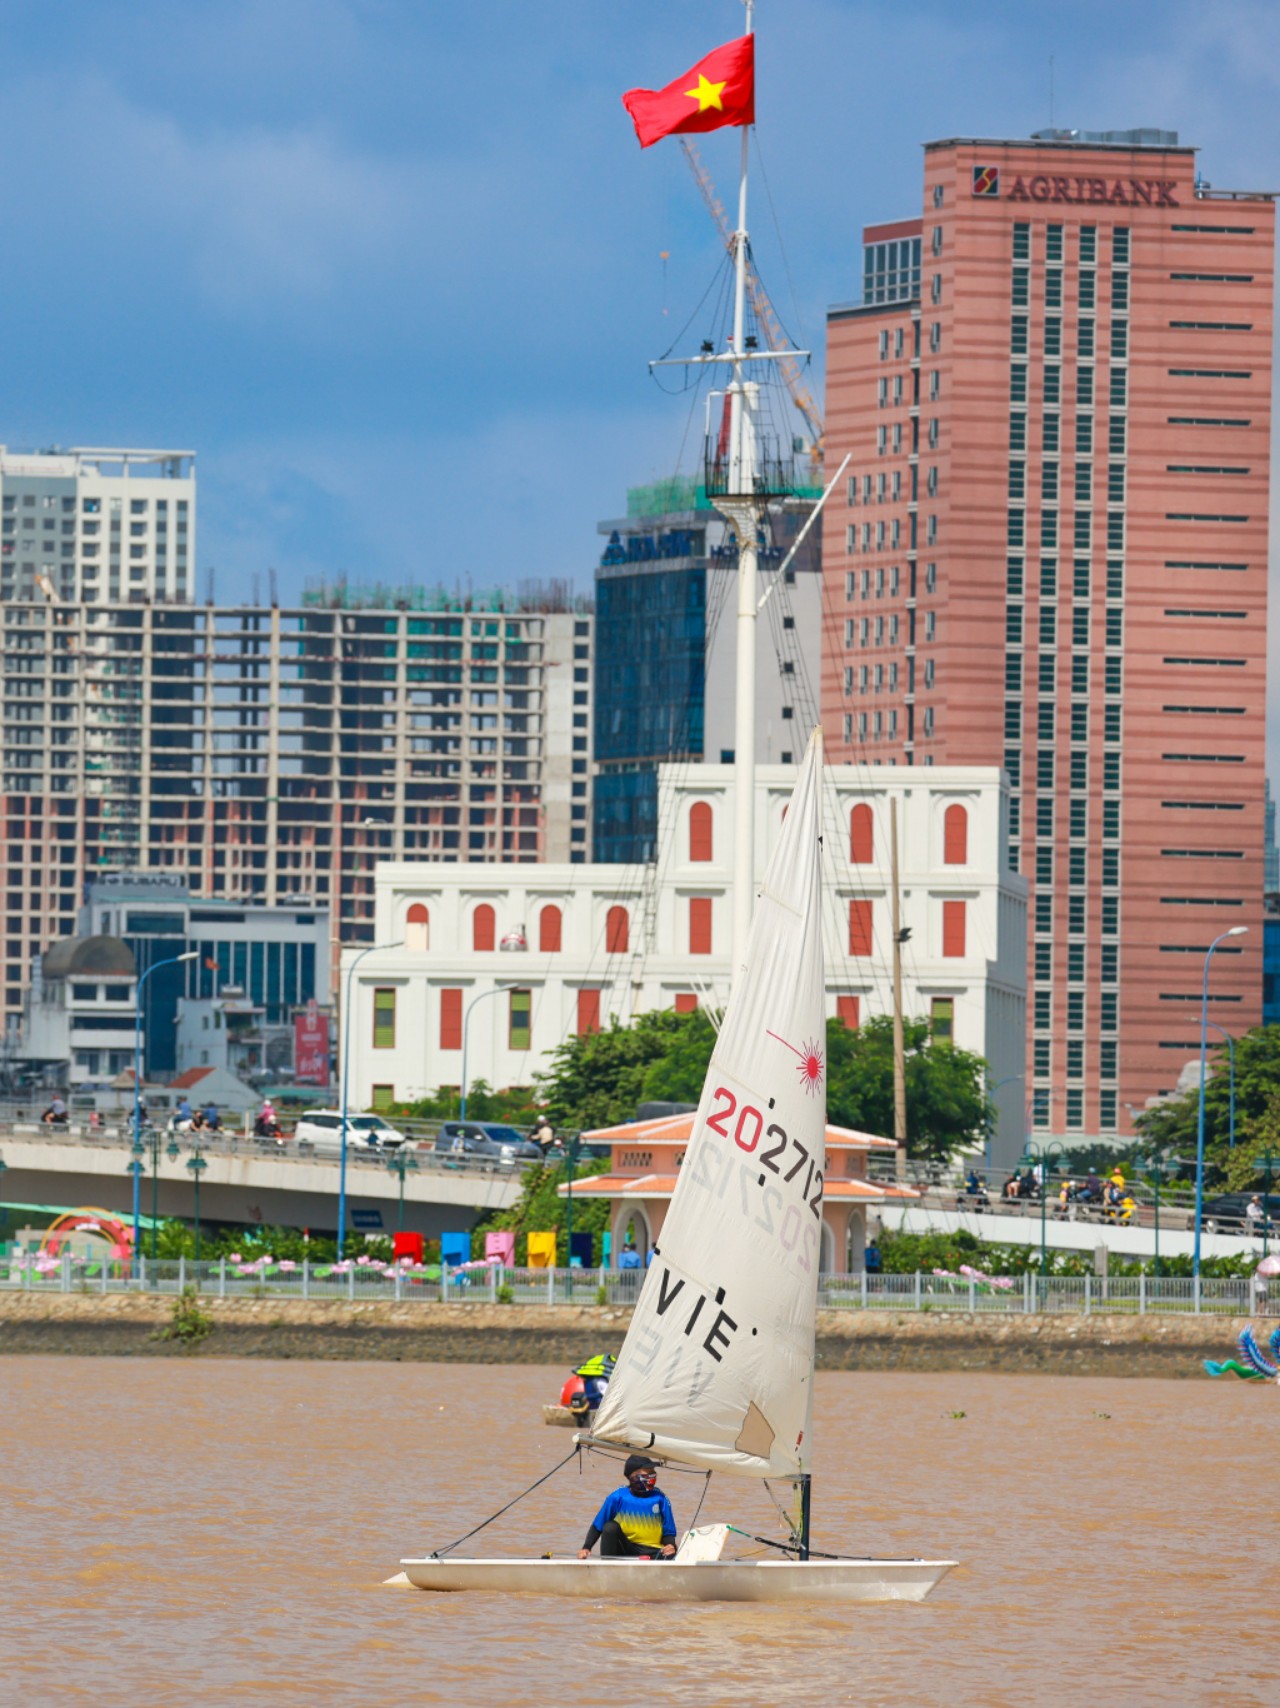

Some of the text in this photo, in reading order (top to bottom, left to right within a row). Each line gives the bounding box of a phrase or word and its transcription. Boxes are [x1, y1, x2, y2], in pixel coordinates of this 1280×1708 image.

[1006, 174, 1180, 208] AGRIBANK
[706, 1086, 824, 1221] 202712
[656, 1267, 739, 1364] VIE
